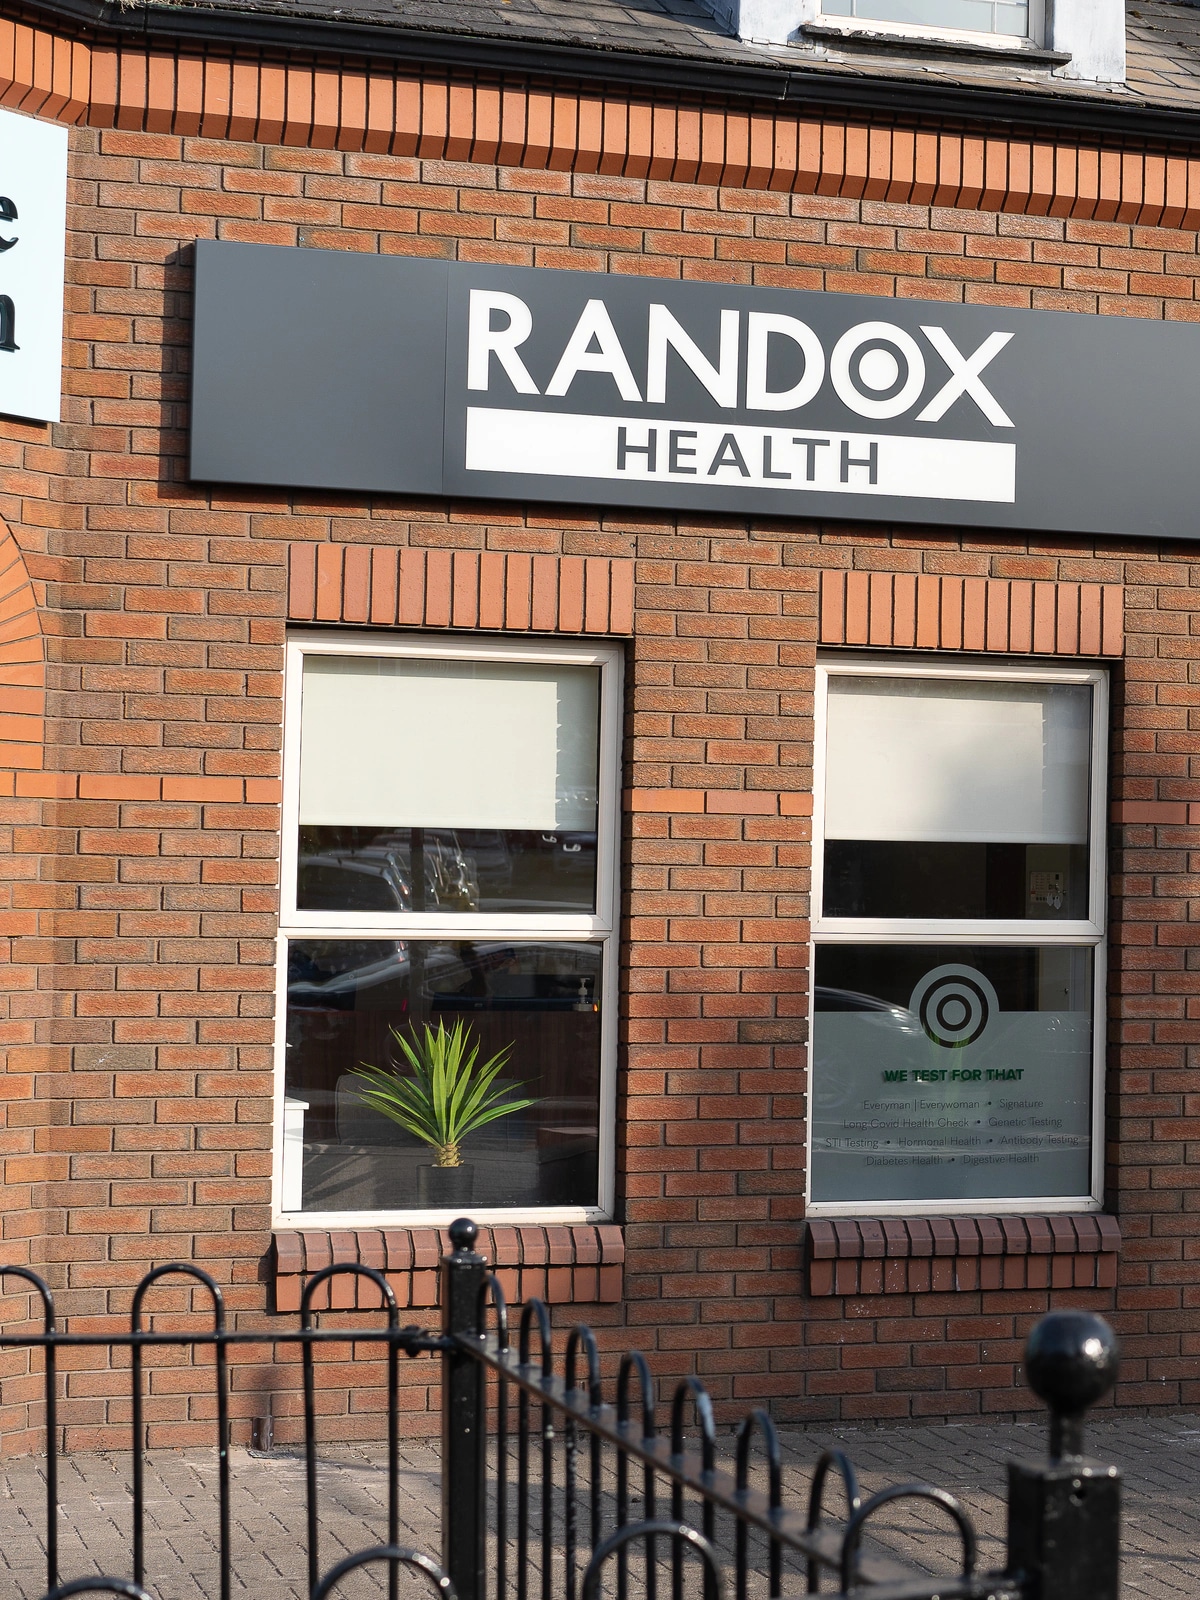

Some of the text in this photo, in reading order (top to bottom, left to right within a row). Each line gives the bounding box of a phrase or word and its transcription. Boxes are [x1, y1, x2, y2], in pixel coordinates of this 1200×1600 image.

[467, 288, 1016, 427] RANDOX
[616, 426, 879, 485] HEALTH
[884, 1068, 1024, 1082] WE TEST FOR THAT
[863, 1099, 1043, 1111] Everyman Everywoman Signature
[843, 1116, 1063, 1131] Long Covid Health Check Genetic Testing
[825, 1134, 1079, 1149] STI Testing Hormonal Health Antibody Testing
[866, 1152, 1040, 1166] Diabetes Health Digestive Health
